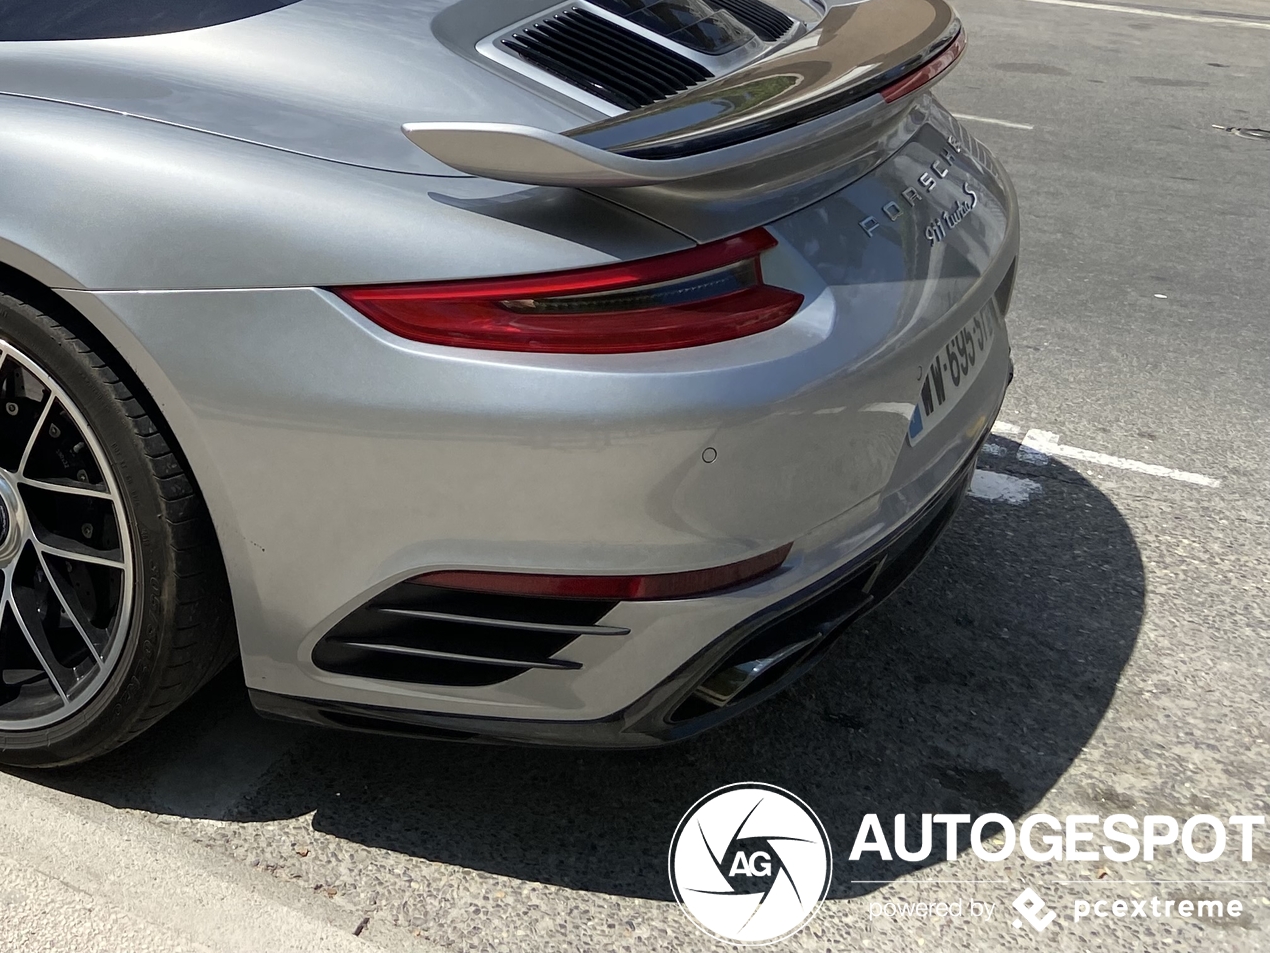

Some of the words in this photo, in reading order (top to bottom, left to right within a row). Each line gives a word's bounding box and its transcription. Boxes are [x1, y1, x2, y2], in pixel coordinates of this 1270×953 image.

[858, 135, 961, 238] PORSCHE
[925, 217, 946, 247] 911
[962, 182, 978, 209] S
